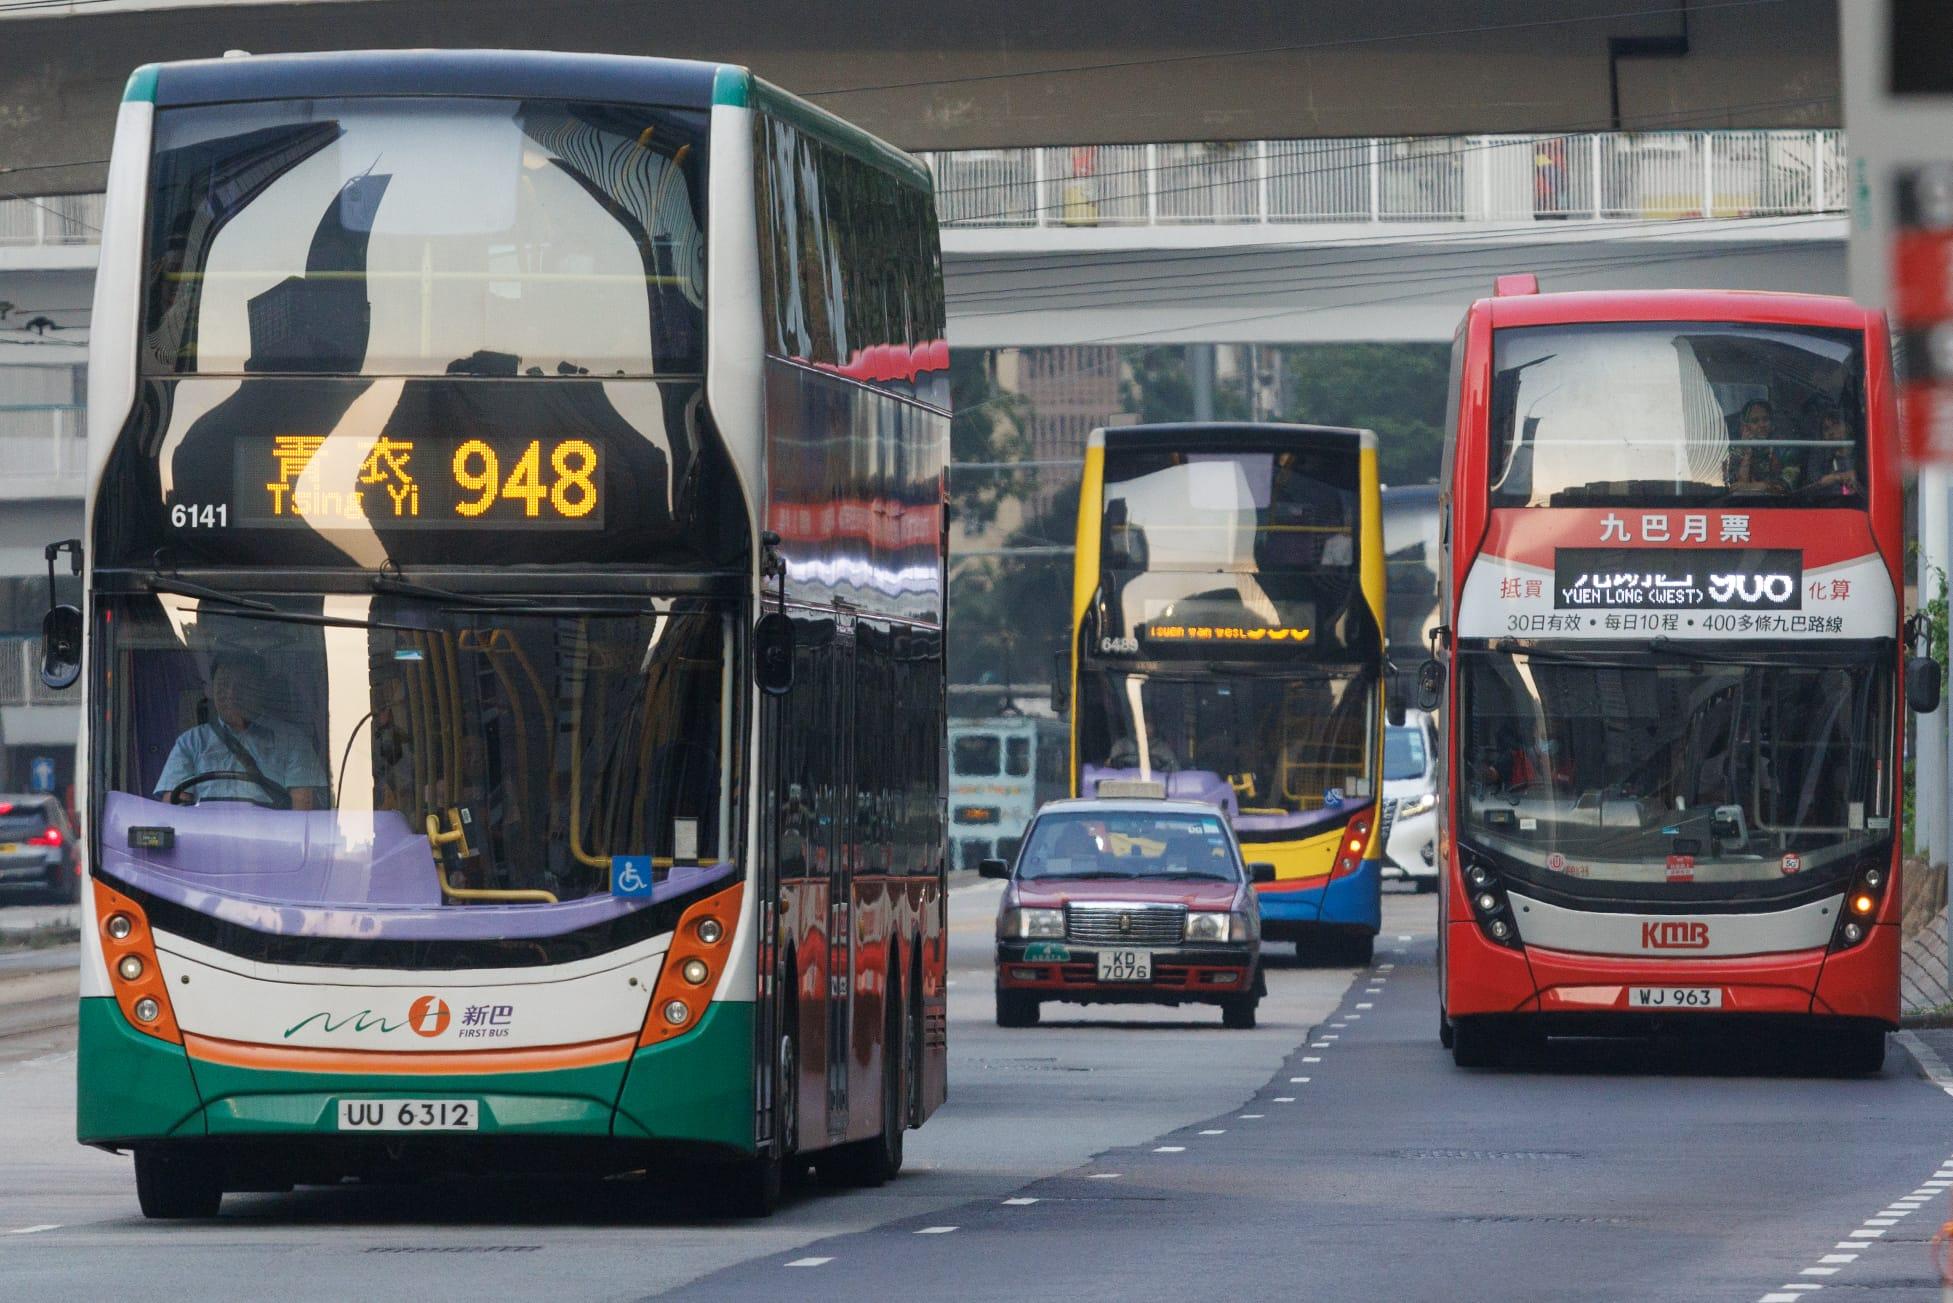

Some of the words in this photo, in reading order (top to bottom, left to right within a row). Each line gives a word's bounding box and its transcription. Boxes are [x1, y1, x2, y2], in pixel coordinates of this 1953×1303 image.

[272, 435, 414, 486] 青衣
[452, 440, 598, 517] 948
[266, 483, 365, 519] Tsing
[386, 483, 420, 516] Yi
[171, 503, 227, 528] 6141
[1600, 512, 1752, 543] 九巴月票
[1500, 575, 1543, 599] 抵買
[1562, 588, 1600, 604] YUEN
[1605, 588, 1643, 604] LONG
[1648, 588, 1704, 605] (WEST)
[1808, 578, 1852, 601] 化算
[1506, 613, 1582, 632] 30日有效
[1604, 613, 1680, 632] 每日10程
[1701, 613, 1844, 634] 400多條九巴路線
[1641, 921, 1711, 949] KMB
[1113, 951, 1136, 965] KD
[1102, 965, 1148, 979] 7076
[1639, 988, 1665, 1006] WJ
[1673, 988, 1711, 1006] 963
[461, 1004, 514, 1026] 新巴
[458, 1027, 487, 1038] FIRST
[488, 1027, 510, 1038] BUS
[347, 1103, 384, 1126] UU
[397, 1103, 469, 1126] 6312
